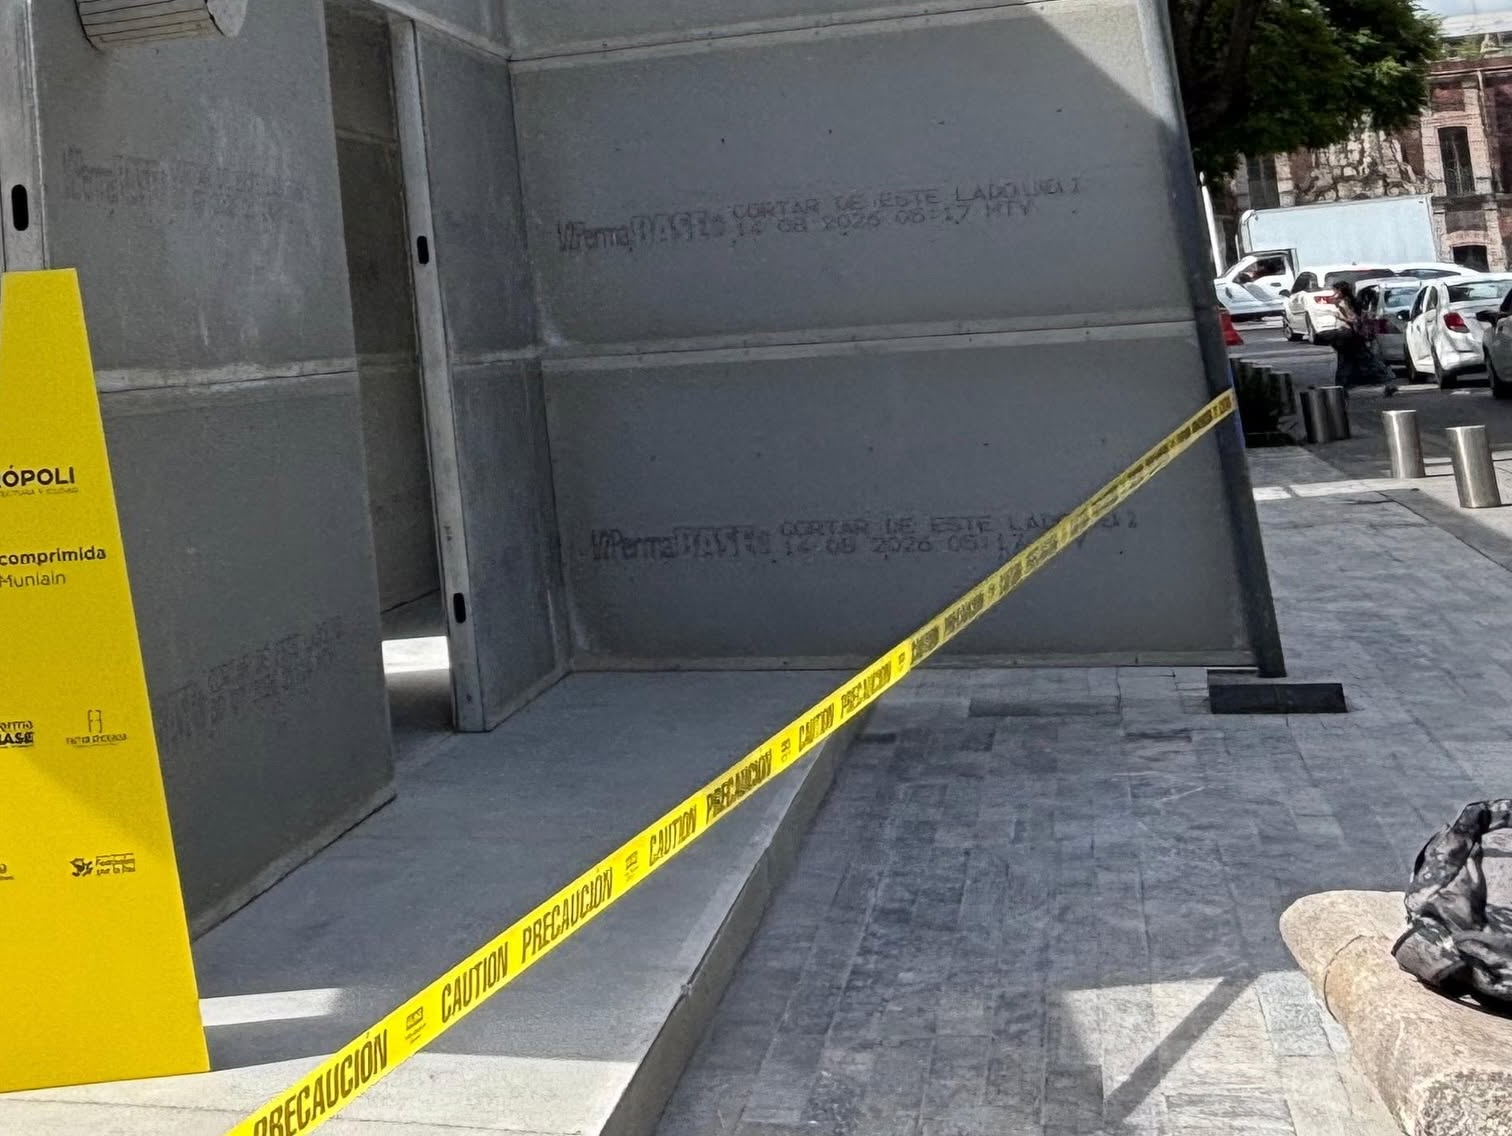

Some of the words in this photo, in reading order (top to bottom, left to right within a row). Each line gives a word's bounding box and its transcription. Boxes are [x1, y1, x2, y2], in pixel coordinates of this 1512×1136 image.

[252, 1028, 389, 1136] PRECAUCIÓN
[440, 940, 510, 1025] CAUTION
[520, 866, 614, 965] PRECAUCIÓN
[648, 803, 698, 867] CAUTION
